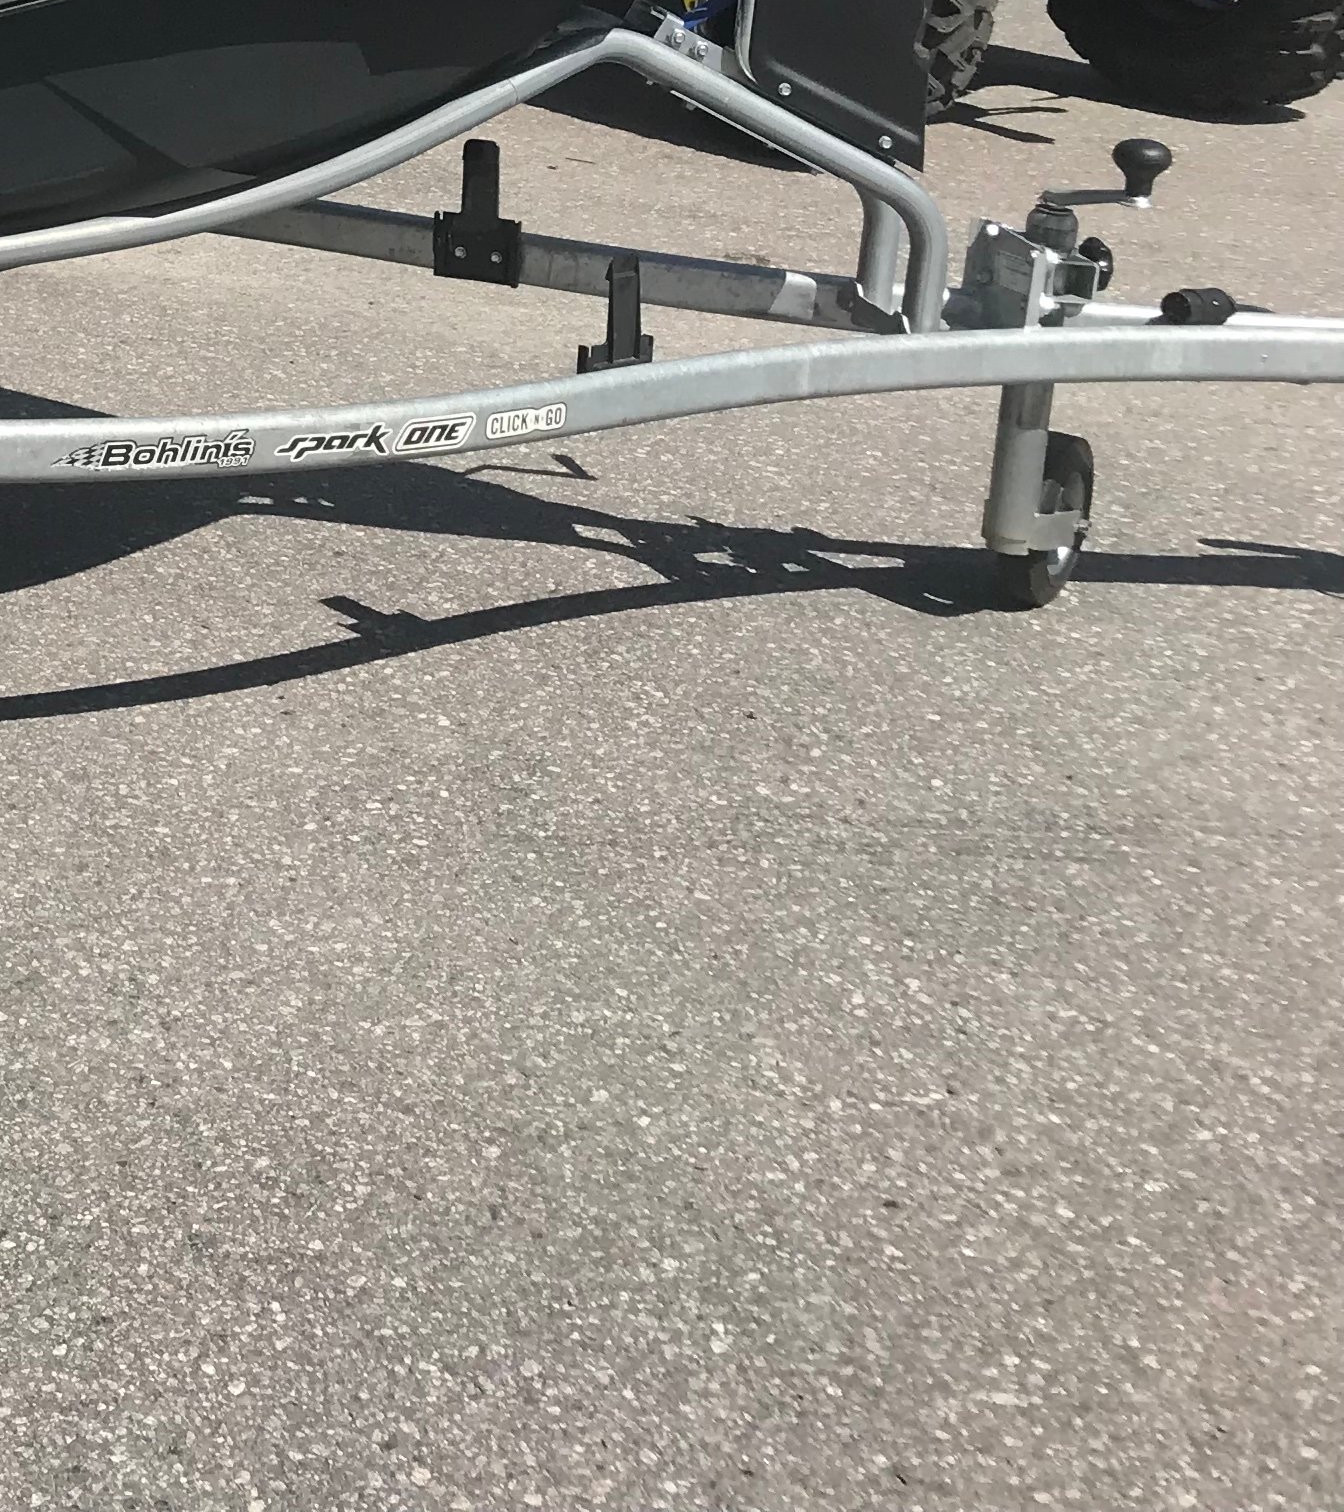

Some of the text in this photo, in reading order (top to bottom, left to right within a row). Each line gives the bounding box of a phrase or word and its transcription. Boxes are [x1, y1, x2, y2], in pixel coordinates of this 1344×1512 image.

[491, 413, 529, 434] CLICK
[546, 407, 562, 426] GO
[275, 421, 468, 460] spark ONE
[219, 457, 250, 468] 1991
